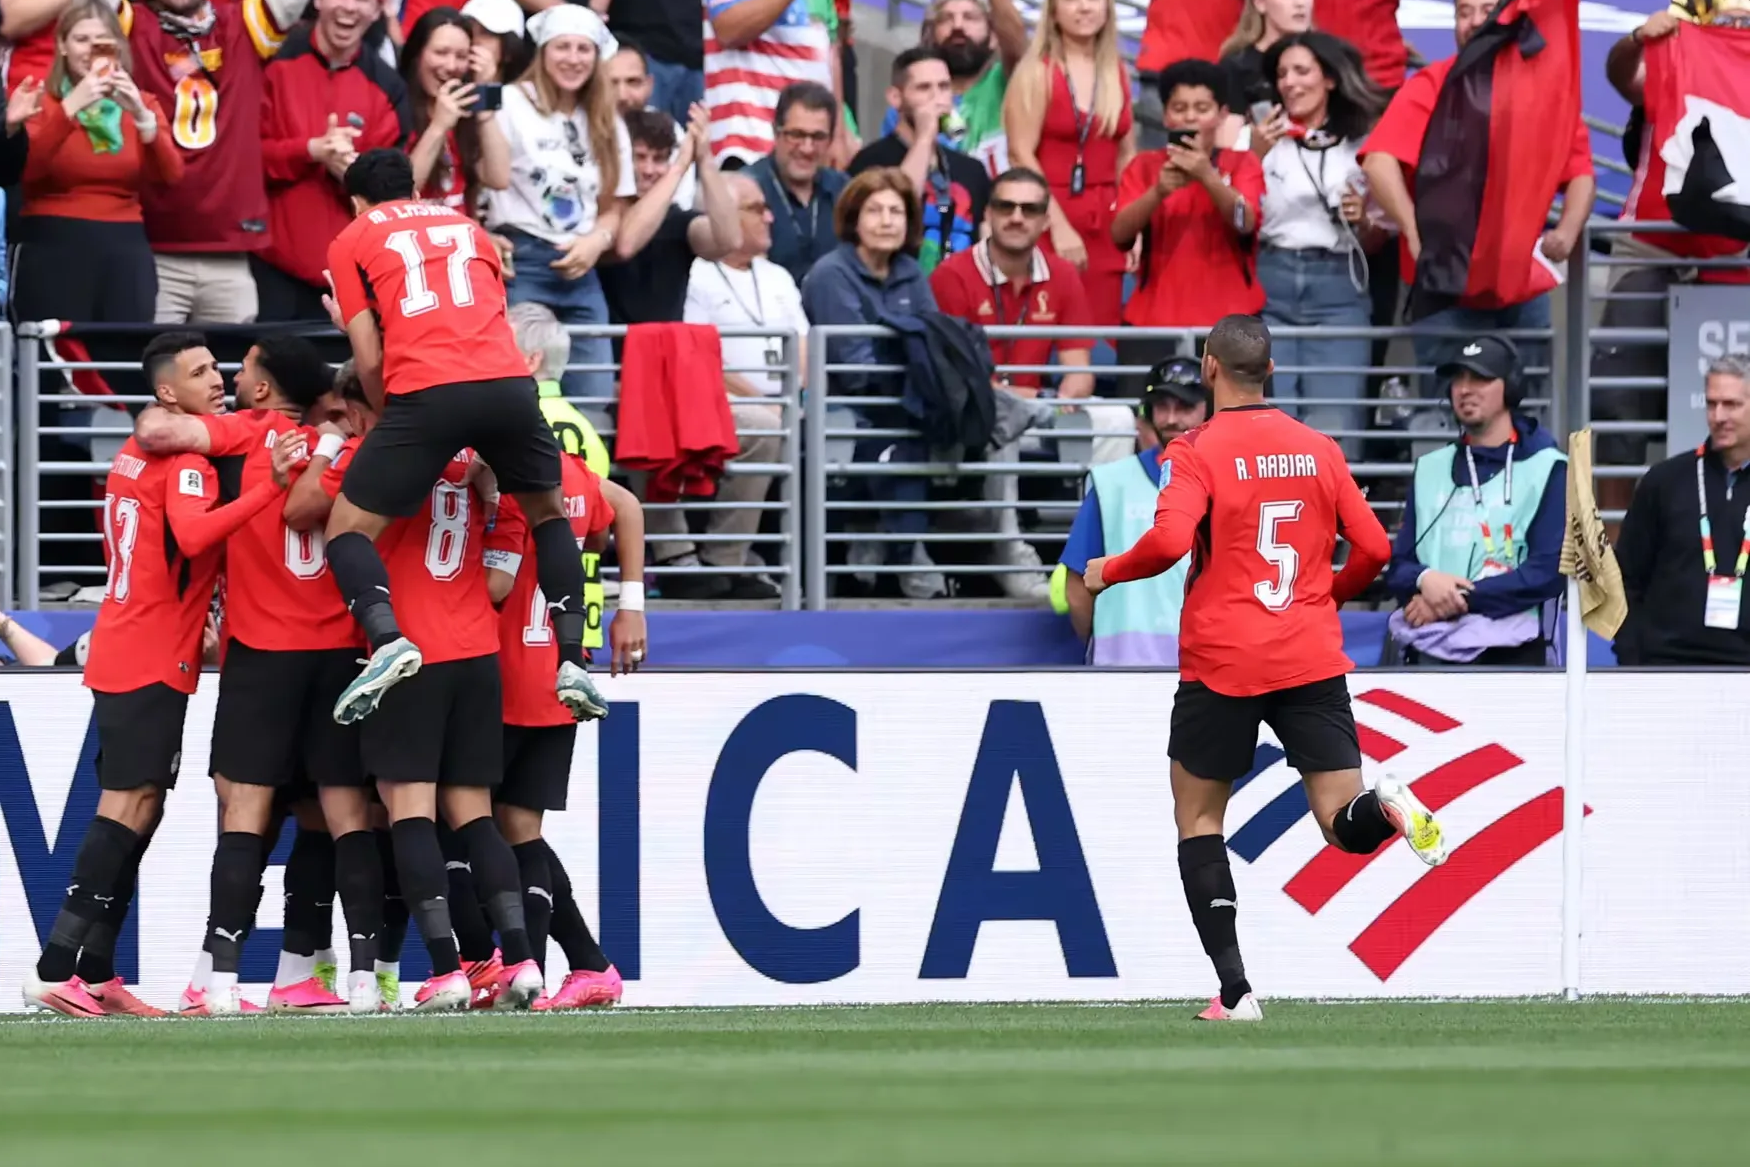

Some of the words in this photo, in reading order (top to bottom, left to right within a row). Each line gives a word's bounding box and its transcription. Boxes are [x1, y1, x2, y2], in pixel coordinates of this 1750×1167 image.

[172, 75, 218, 149] 0
[384, 223, 477, 318] 17
[1234, 457, 1253, 480] R.
[1256, 454, 1317, 479] RABIAA
[424, 478, 472, 582] 8
[1253, 499, 1305, 611] 5
